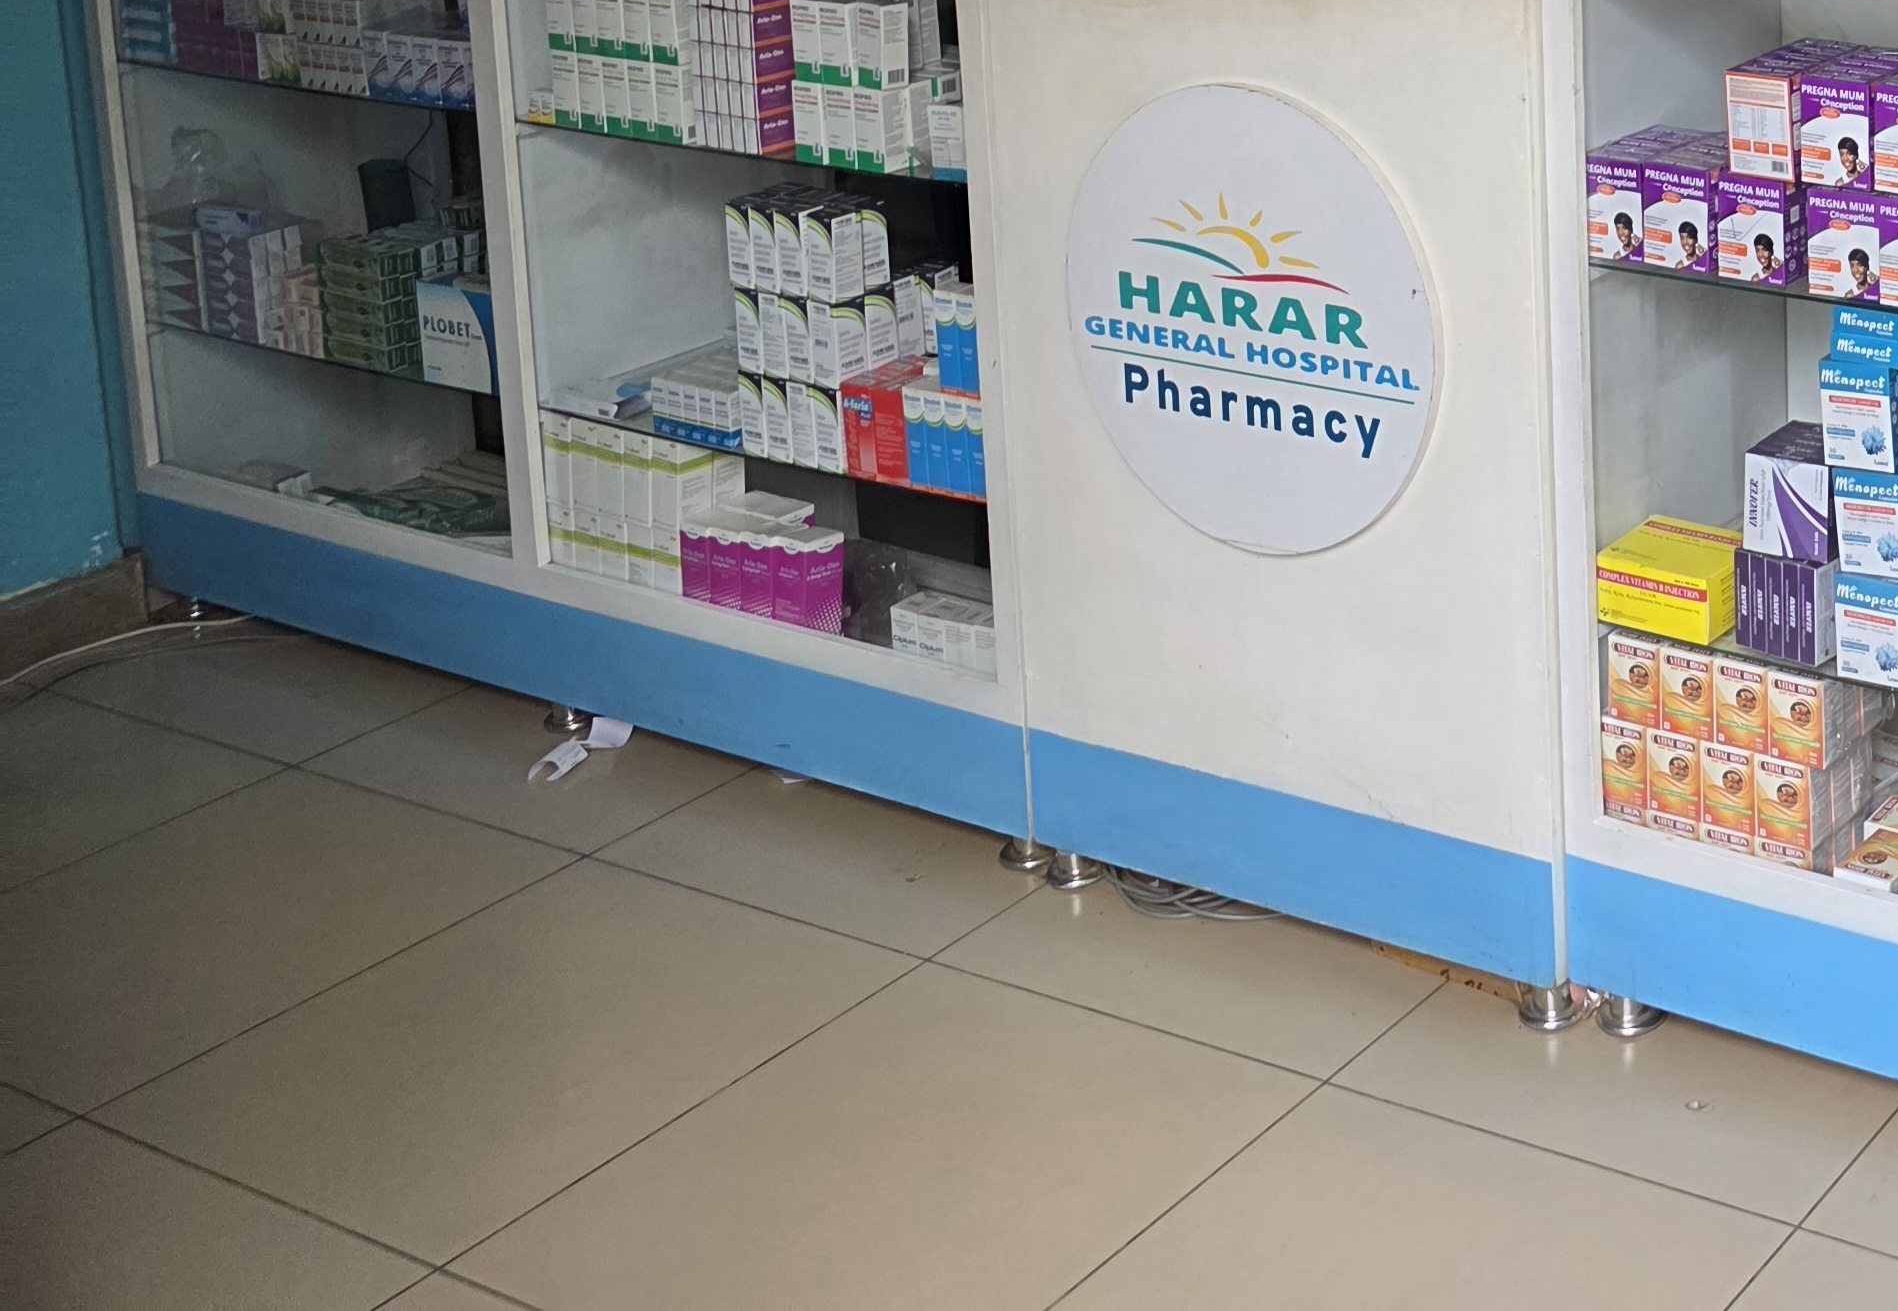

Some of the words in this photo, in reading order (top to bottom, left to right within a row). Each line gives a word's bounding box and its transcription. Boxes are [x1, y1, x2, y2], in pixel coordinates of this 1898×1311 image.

[1801, 83, 1838, 99] PREGNA
[1839, 89, 1865, 103] MUM
[1819, 97, 1865, 112] Conception
[1644, 169, 1679, 185] PREGNA
[1680, 175, 1705, 189] MUM
[1662, 183, 1705, 197] Conception
[1809, 195, 1847, 211] PREGNA
[1849, 200, 1875, 215] MUM
[1829, 209, 1876, 225] Conception
[1118, 270, 1369, 350] HARAR
[422, 315, 471, 338] PLOBET
[1840, 312, 1895, 336] Menopect
[1084, 315, 1236, 360] GENERAL
[1246, 341, 1421, 392] HOSPITAL
[1821, 369, 1887, 391] Menopect
[1122, 362, 1382, 460] Pharmacy
[1598, 569, 1630, 585] COMPLEX
[1630, 574, 1658, 590] VITAMIN
[1665, 582, 1701, 600] INJECTION
